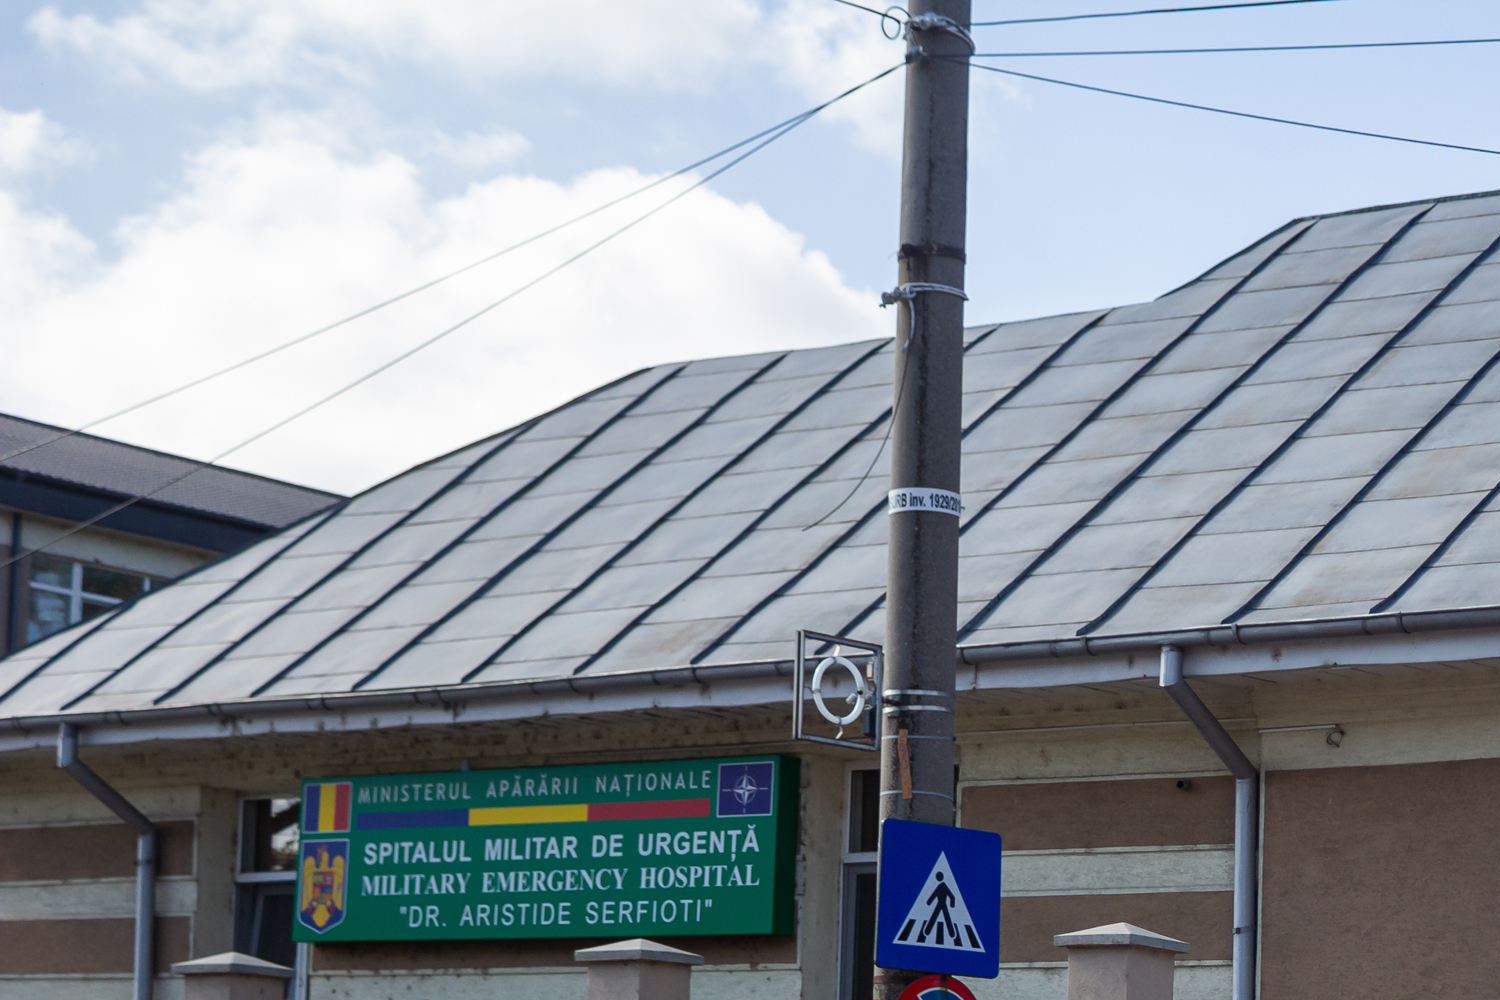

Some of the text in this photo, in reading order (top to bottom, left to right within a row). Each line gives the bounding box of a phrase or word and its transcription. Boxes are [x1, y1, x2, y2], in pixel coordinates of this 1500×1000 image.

[909, 492, 926, 507] inv.
[357, 770, 712, 804] MINISTERUL APĂRĂRII NAȚIONALE
[363, 824, 760, 866] SPITALUL MILITAR DE URGENȚĂ
[361, 864, 760, 897] MILITARY EMERGENCY HOSPITAL
[399, 898, 713, 928] "DR. ARISTIDE SERFIOTI"
